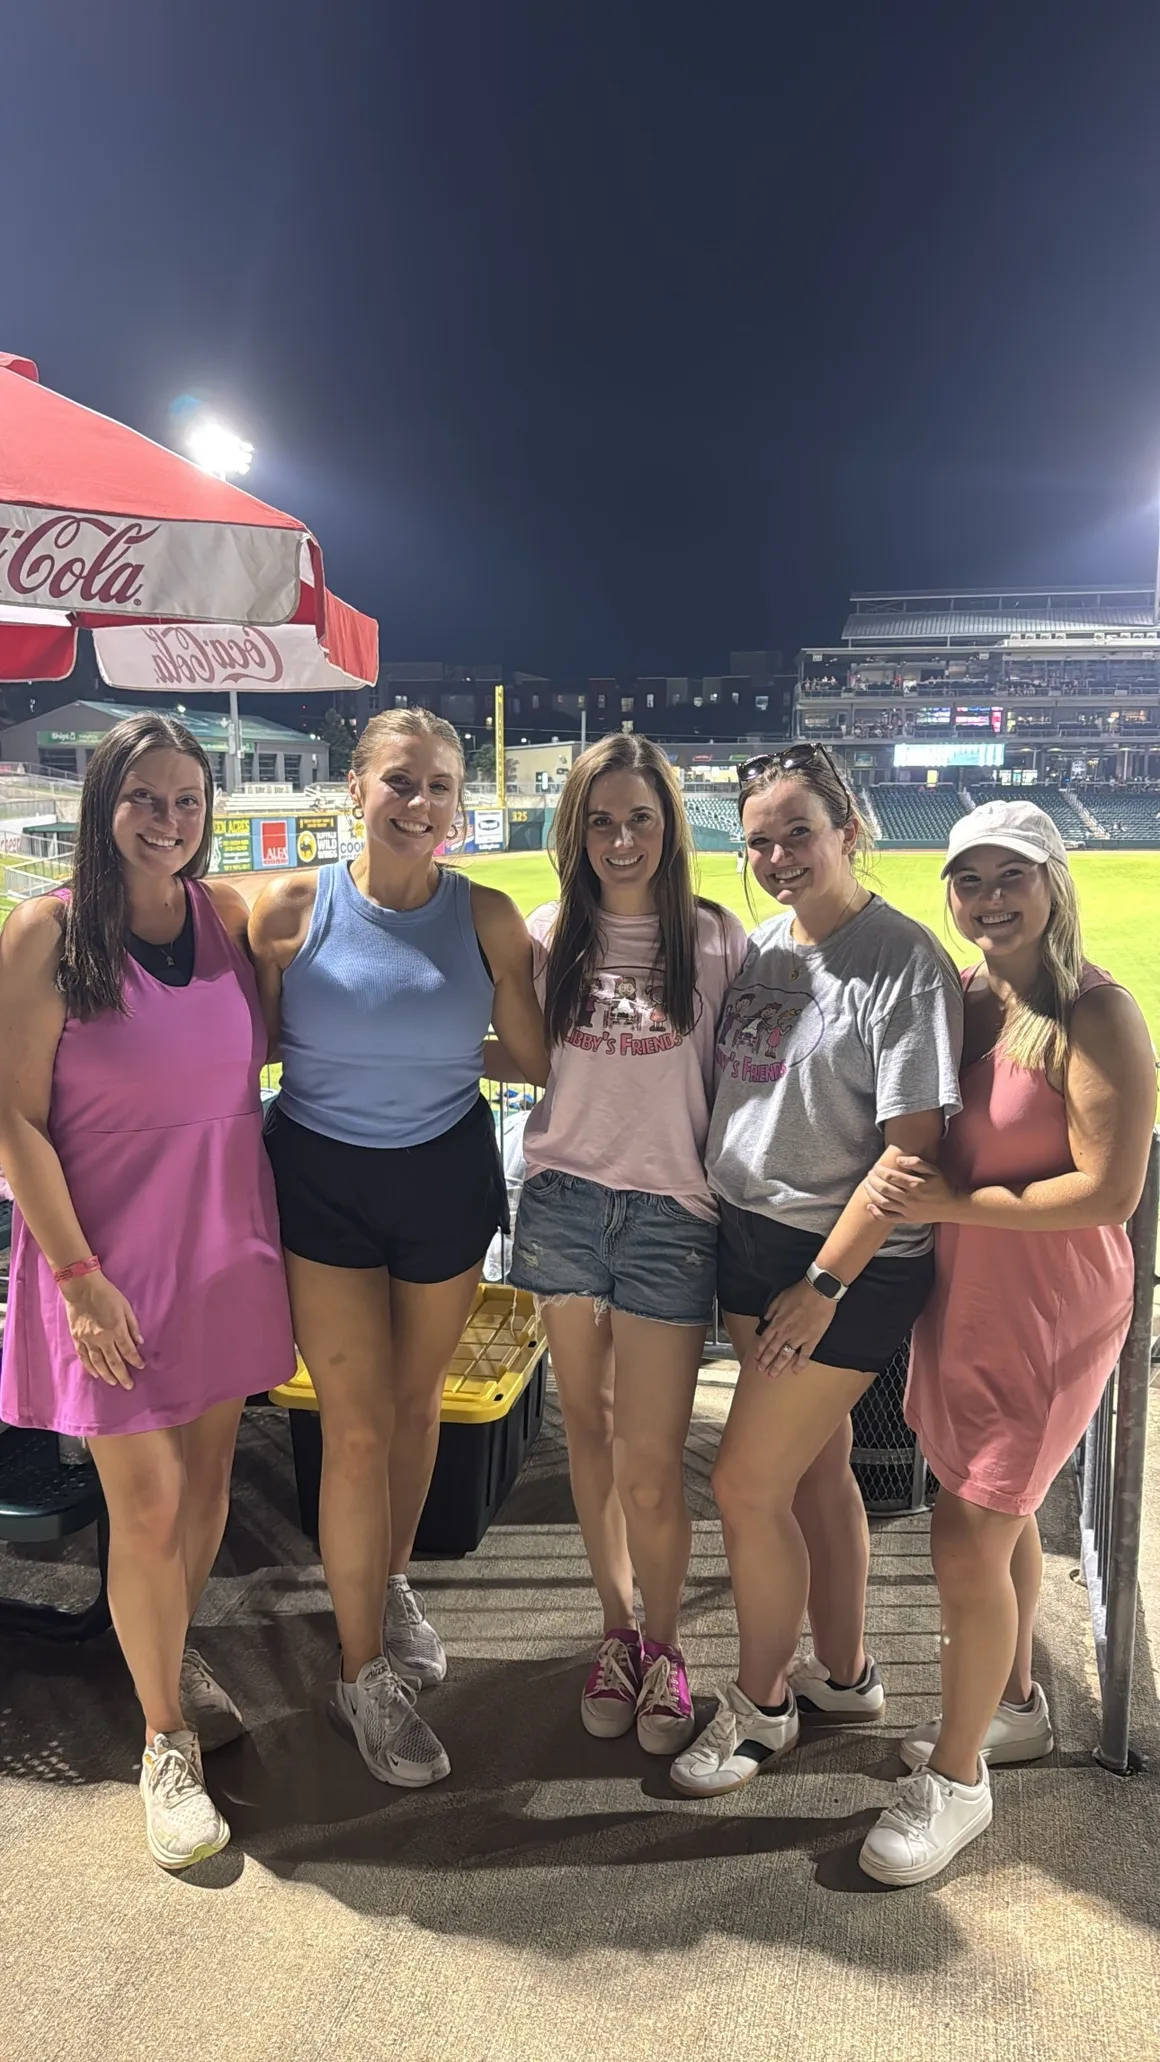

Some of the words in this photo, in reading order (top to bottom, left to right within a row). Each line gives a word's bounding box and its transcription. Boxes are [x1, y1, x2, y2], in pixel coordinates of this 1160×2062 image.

[0, 515, 161, 605] -Cola
[512, 811, 528, 822] 325
[228, 819, 250, 834] ACRES
[317, 839, 337, 850] WILD
[267, 847, 288, 860] ALFA
[317, 850, 338, 860] WINGS
[620, 1031, 683, 1056] FRIENDS
[742, 1056, 788, 1083] FRIENDS
